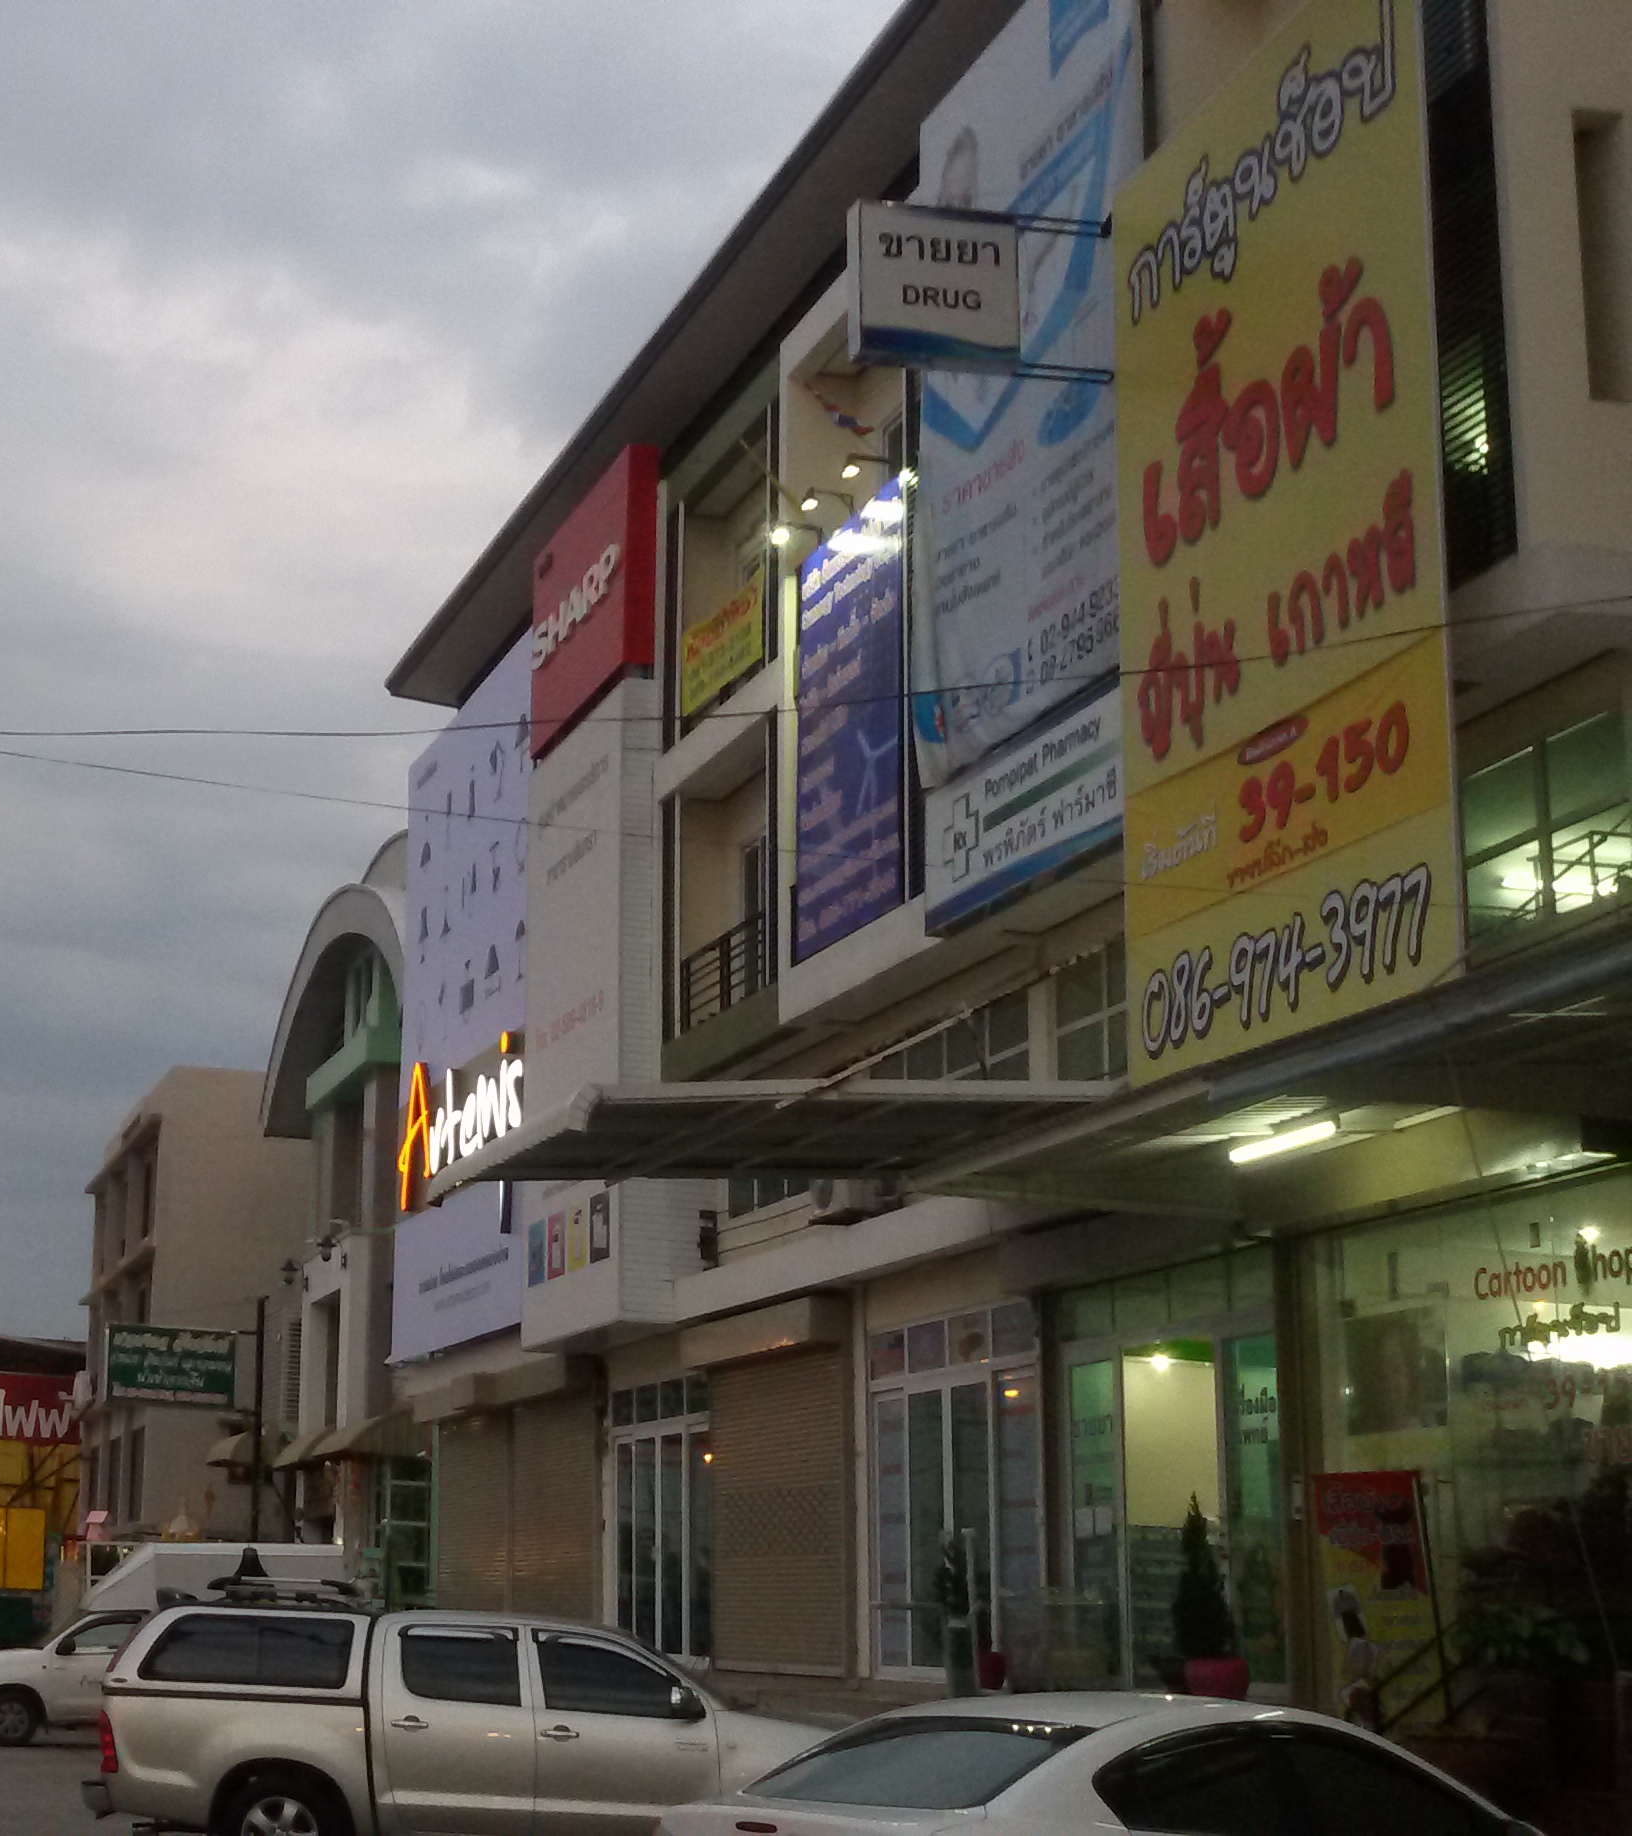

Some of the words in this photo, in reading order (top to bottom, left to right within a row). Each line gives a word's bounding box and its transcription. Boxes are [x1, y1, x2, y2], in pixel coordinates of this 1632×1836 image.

[878, 231, 1001, 267] ขายยา
[901, 284, 982, 310] DRUG
[1142, 256, 1395, 564] เสื้อผ้า
[531, 543, 621, 672] SHARP
[1268, 468, 1418, 668] เกาหลี
[1042, 714, 1102, 768] Pharmacy
[1237, 701, 1409, 844] 39-150
[1142, 861, 1433, 1060] 086-974-3977
[1474, 1260, 1567, 1300] Cartoon
